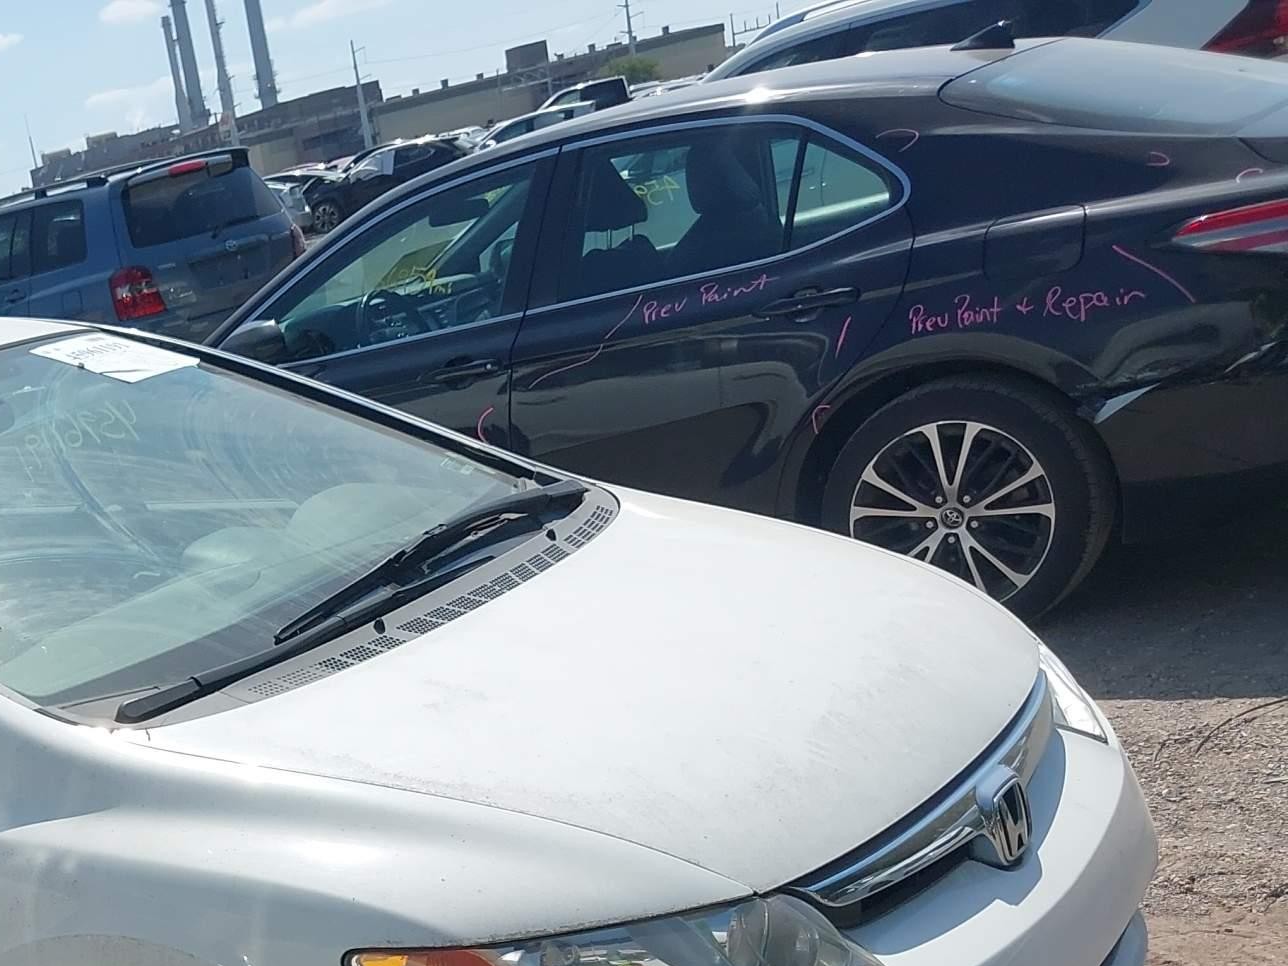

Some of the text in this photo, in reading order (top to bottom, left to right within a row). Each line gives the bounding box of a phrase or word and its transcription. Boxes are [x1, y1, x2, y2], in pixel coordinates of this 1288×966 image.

[642, 273, 780, 325] Prev Paint
[908, 304, 949, 334] Prev
[954, 294, 1003, 328] Paint
[1042, 285, 1146, 322] Repair
